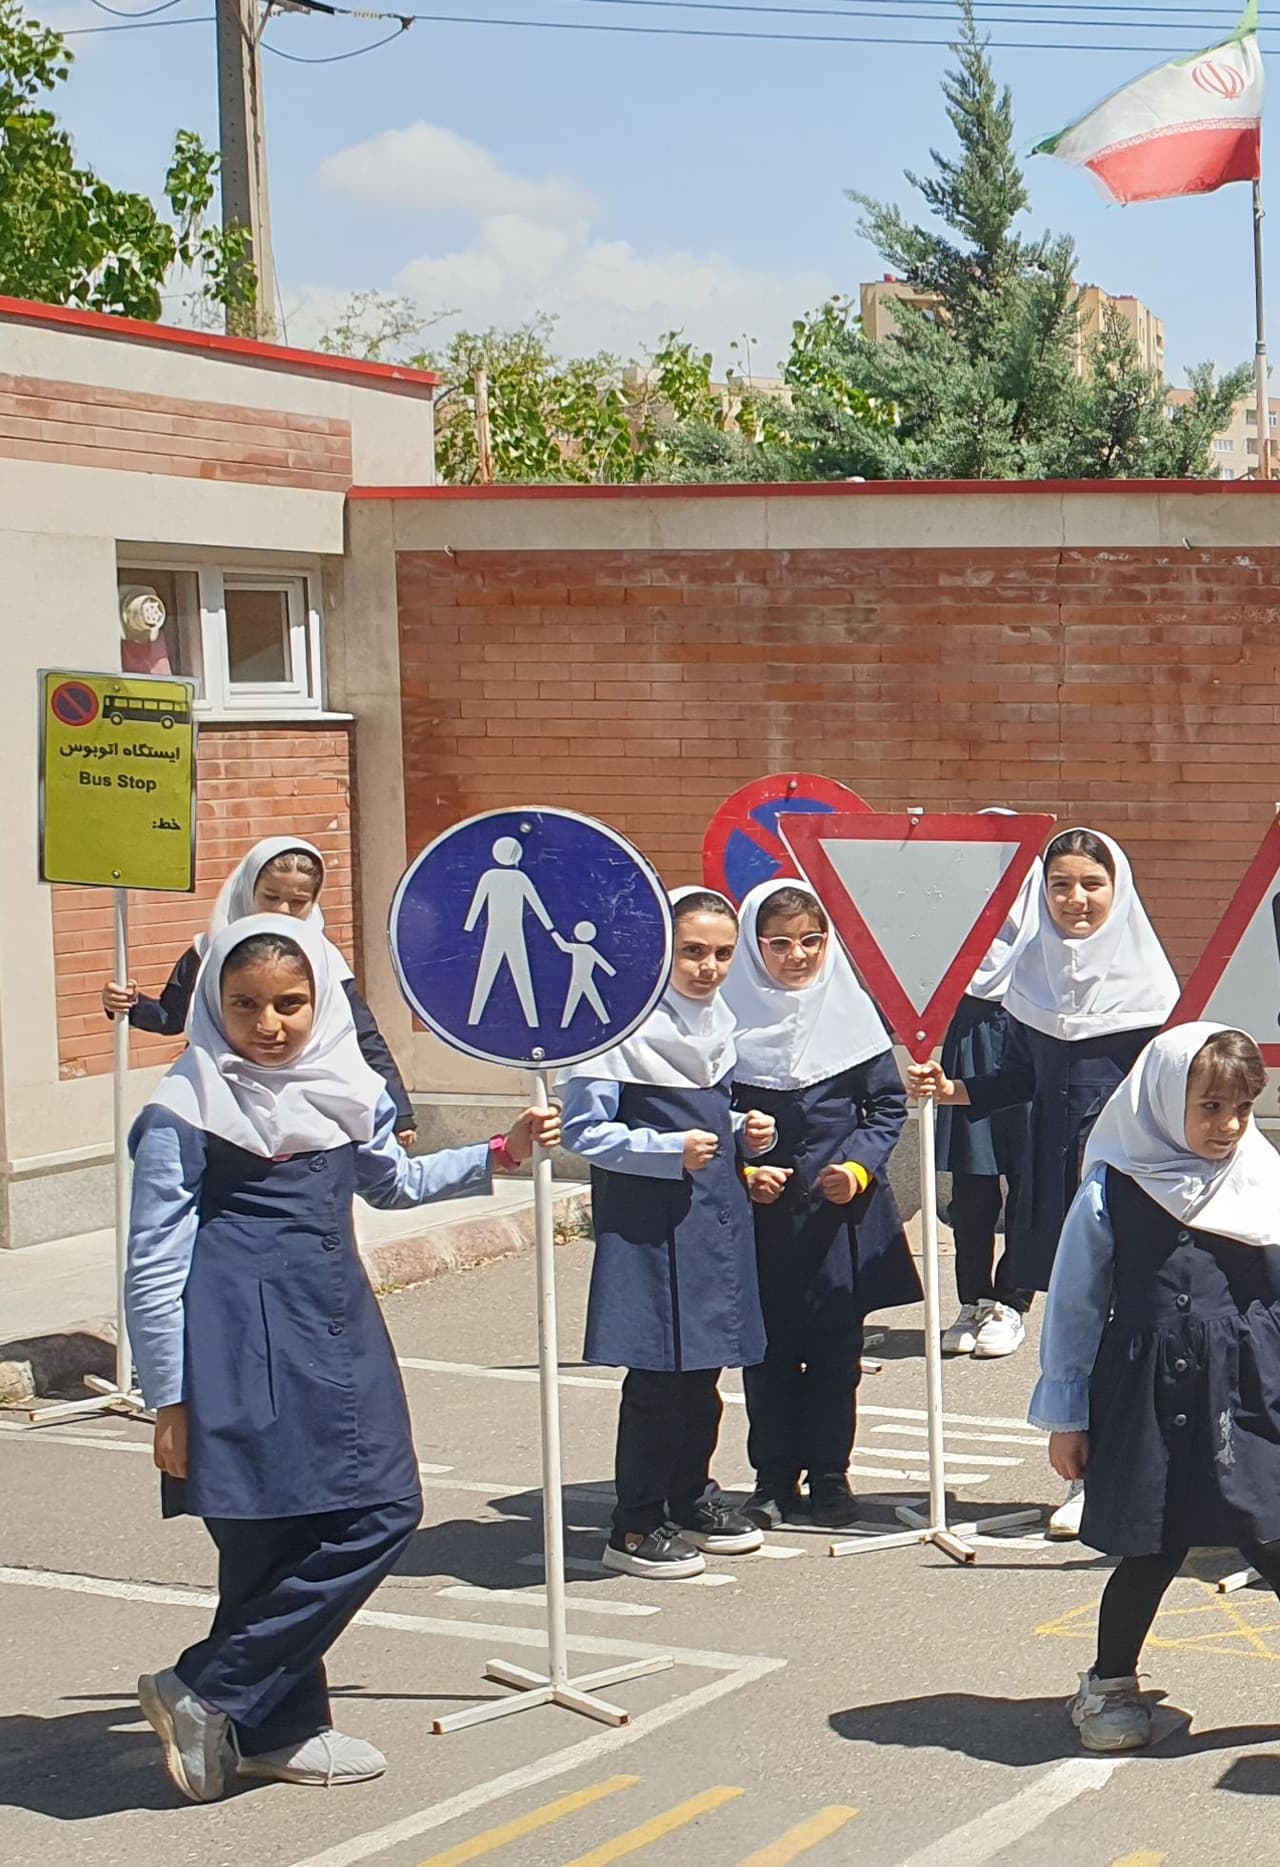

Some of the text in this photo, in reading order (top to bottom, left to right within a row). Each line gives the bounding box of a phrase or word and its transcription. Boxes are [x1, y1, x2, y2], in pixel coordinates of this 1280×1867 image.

[60, 743, 180, 763] ایستگاه اتوبوس
[79, 771, 157, 793] Bus Stop
